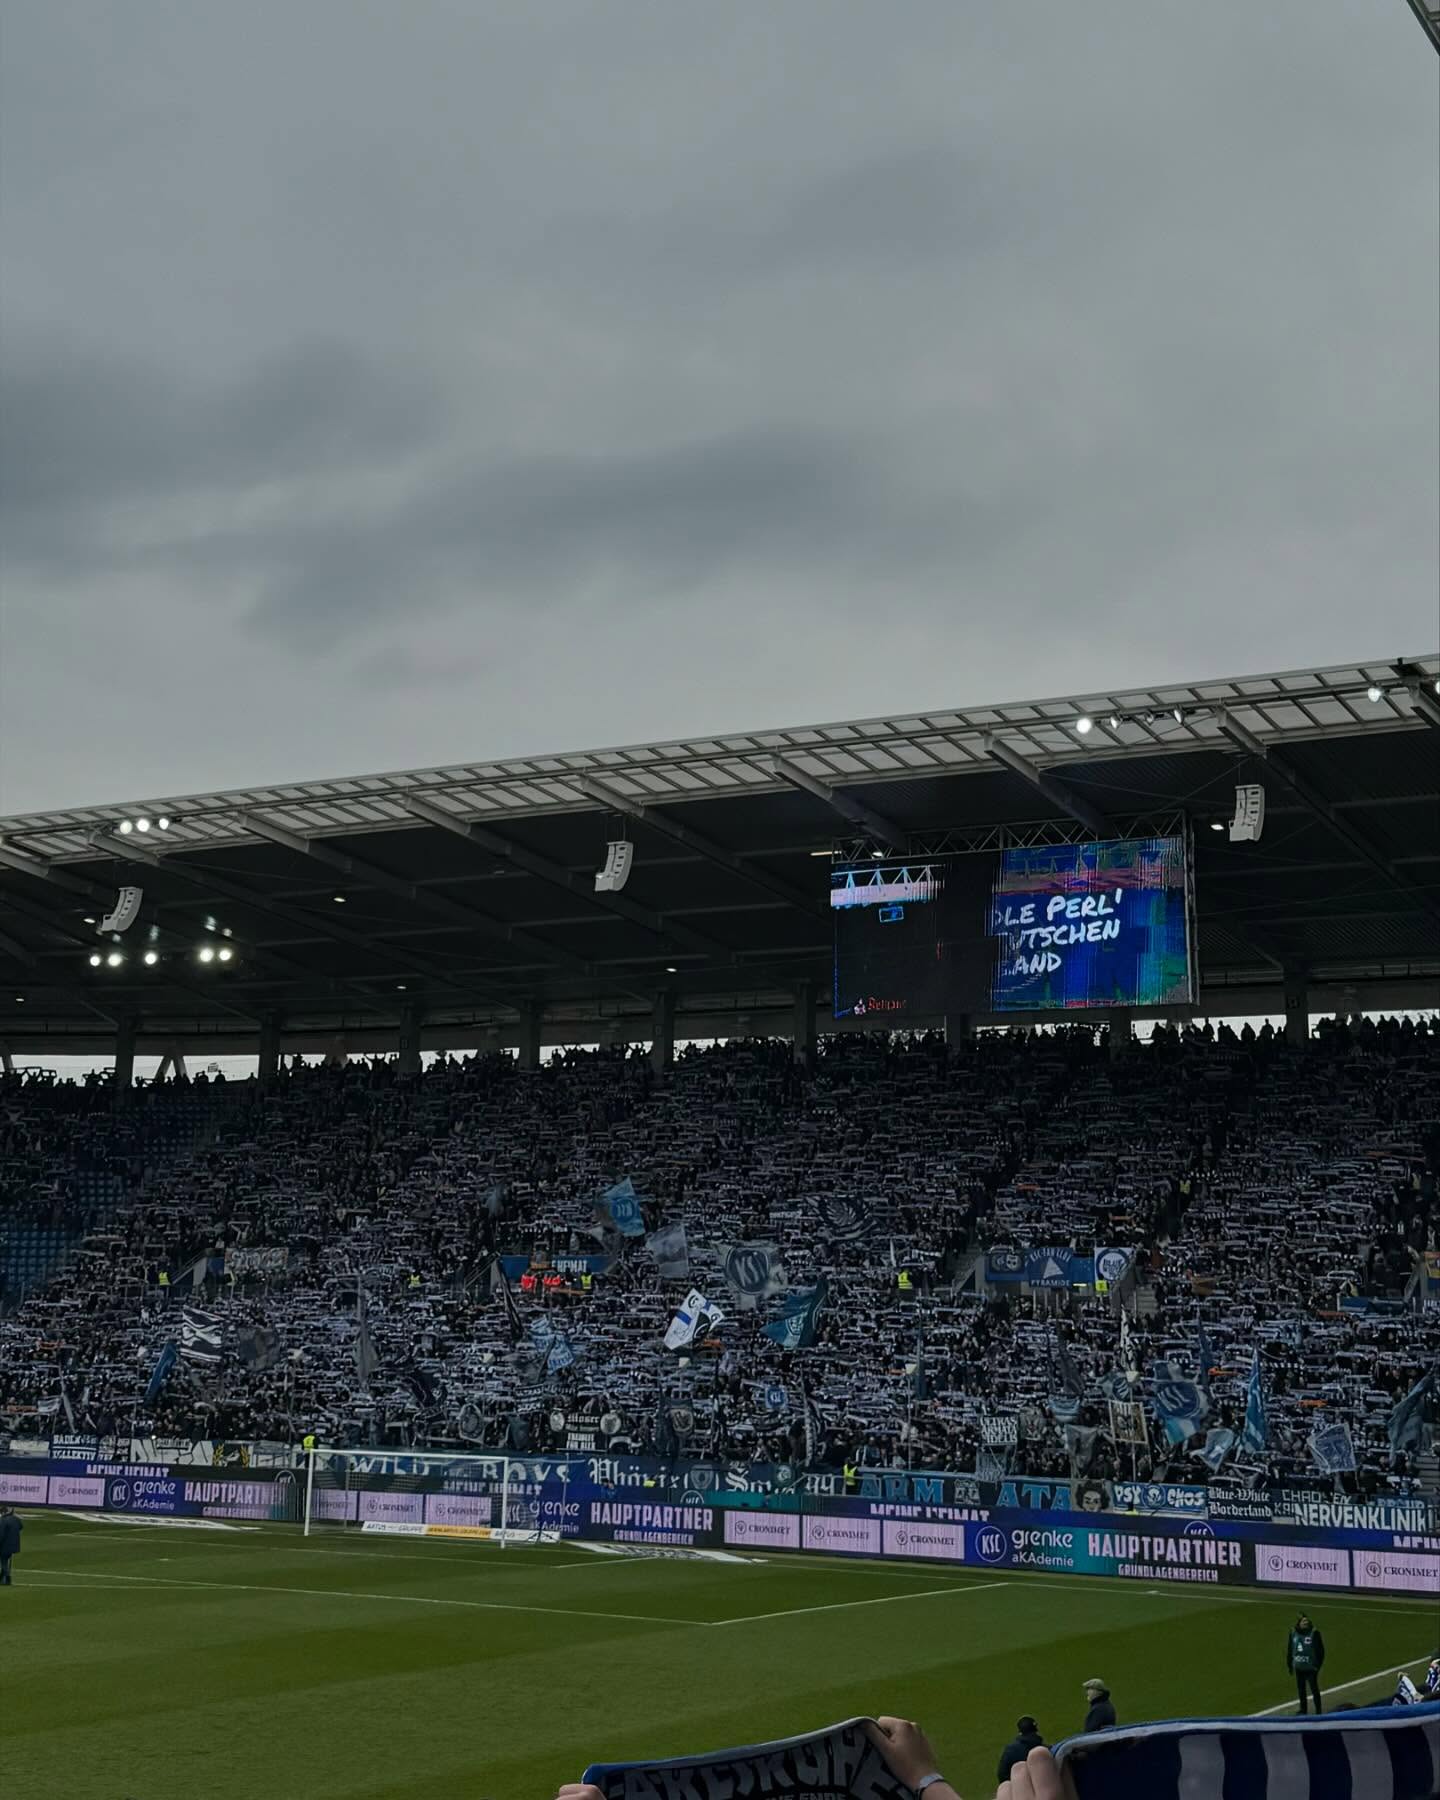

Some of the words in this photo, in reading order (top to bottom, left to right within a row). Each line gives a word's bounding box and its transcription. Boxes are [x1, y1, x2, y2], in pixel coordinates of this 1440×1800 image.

[588, 1458, 681, 1489] Phöix
[133, 1480, 176, 1497] grenke
[591, 1502, 713, 1531] HAUPTPARTNER
[910, 1535, 954, 1546] CRONIMET
[982, 1534, 1001, 1555] KSC
[1011, 1529, 1074, 1549] grenke
[1012, 1551, 1074, 1567] aKAdemie
[1088, 1533, 1242, 1567] HAUPTPARTNER
[1118, 1563, 1219, 1583] GRUNDLAGENBEREICH
[1286, 1559, 1338, 1572] CRONIMET
[1384, 1566, 1439, 1578] CRONIMET
